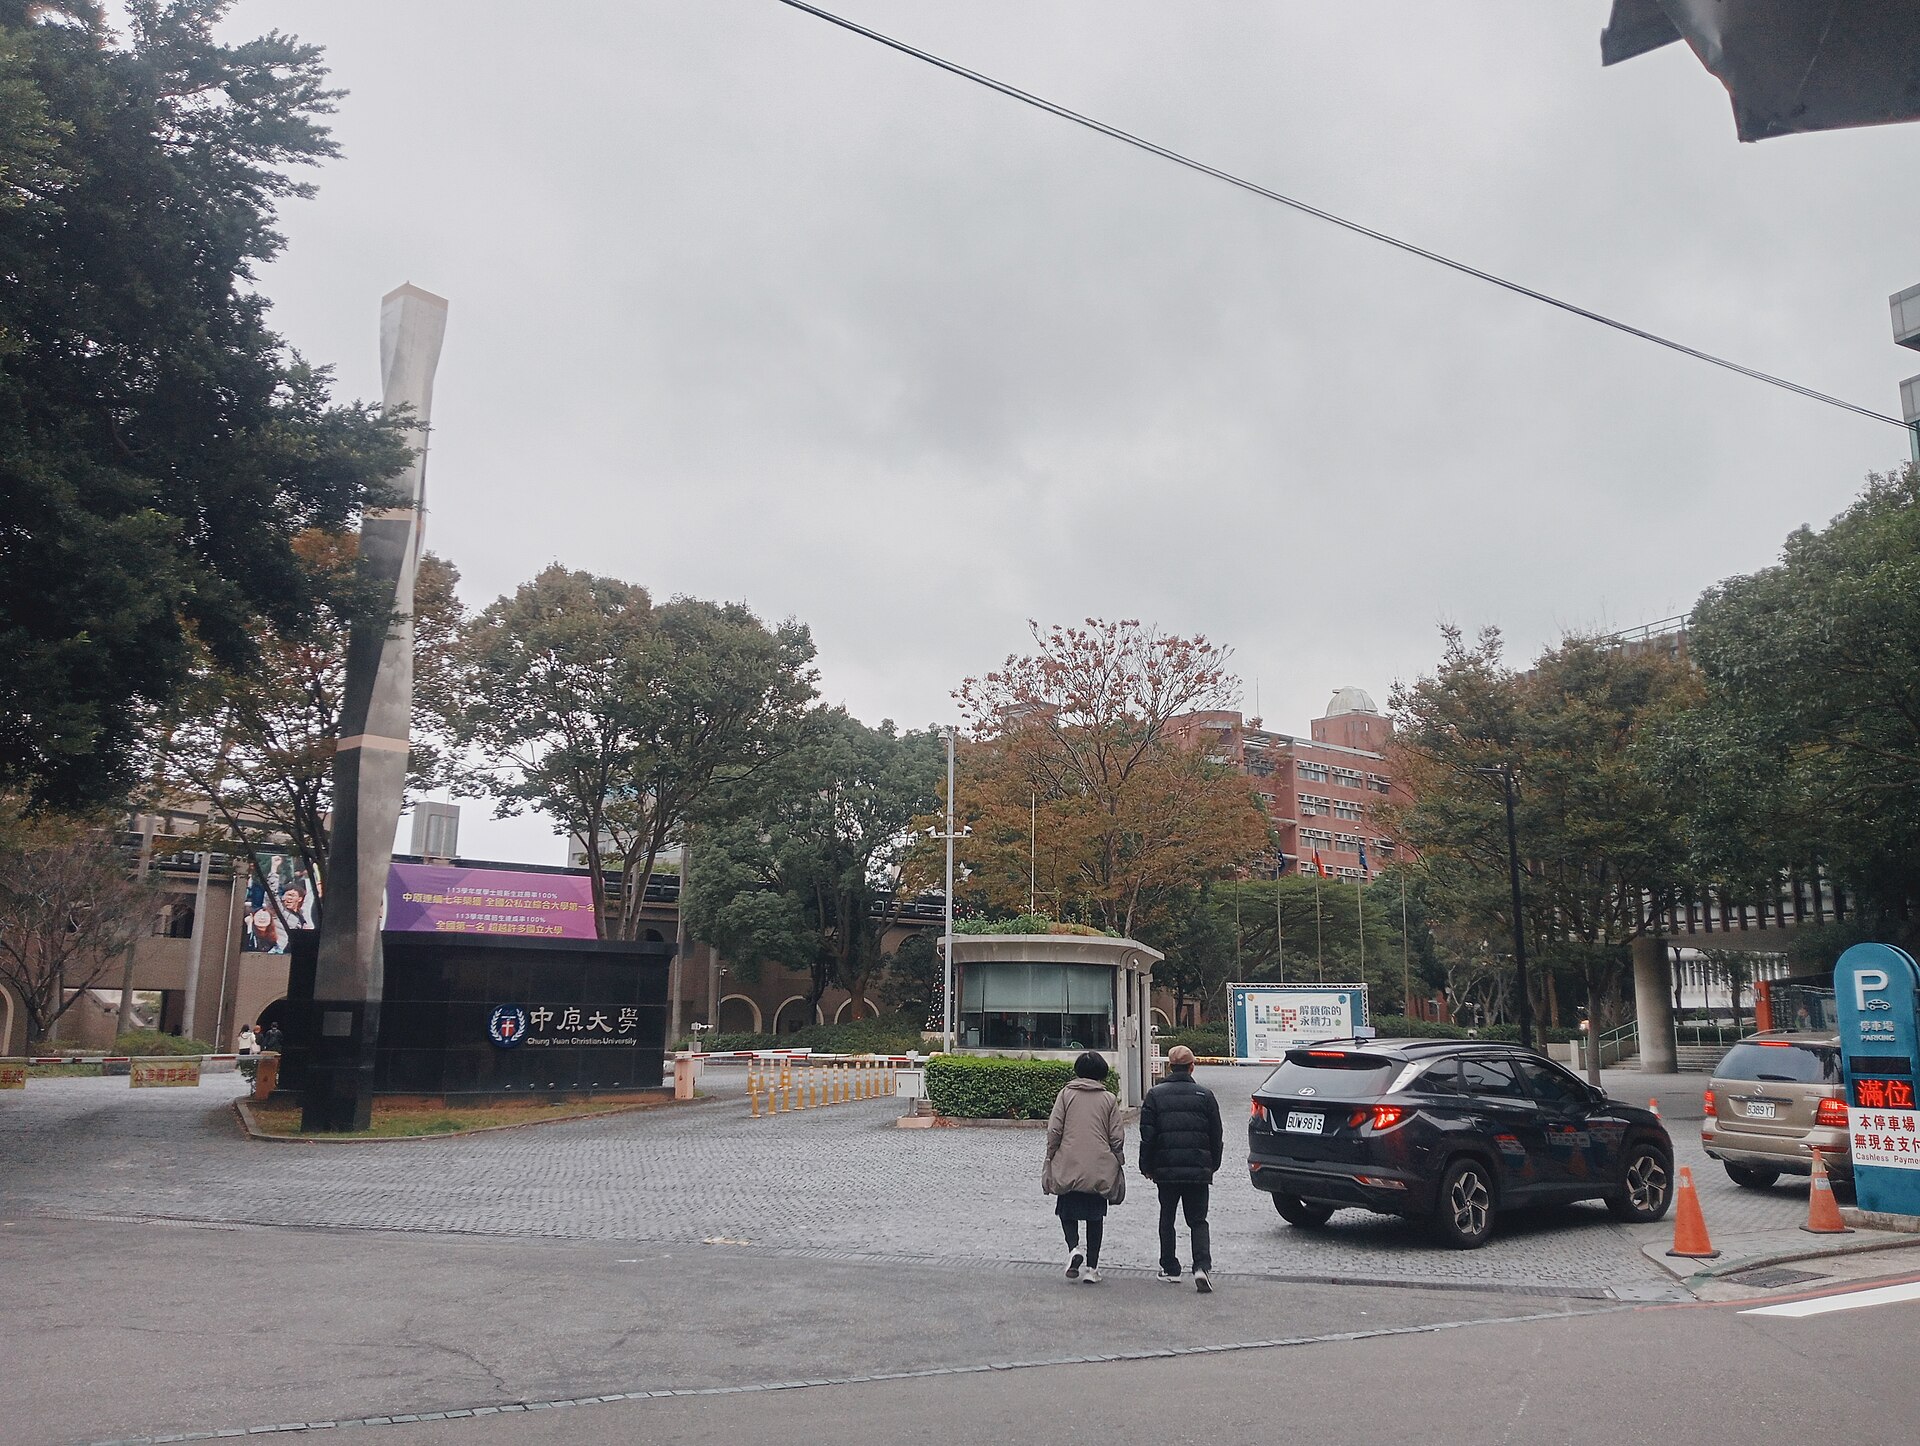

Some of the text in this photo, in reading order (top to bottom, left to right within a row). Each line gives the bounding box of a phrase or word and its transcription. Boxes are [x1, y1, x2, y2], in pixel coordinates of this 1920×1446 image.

[436, 920, 486, 932] 全國第一名
[1853, 969, 1889, 1011] P
[1299, 1005, 1342, 1016] 解鎖你的
[530, 1006, 639, 1034] 中原大學
[1299, 1016, 1331, 1026] 永續力
[1860, 1020, 1895, 1032] 停車場
[527, 1037, 550, 1046] Chung
[571, 1037, 602, 1045] Christian
[603, 1037, 637, 1047] University
[1860, 1034, 1895, 1042] PARKING
[1858, 1080, 1913, 1107] 滿位
[1859, 1114, 1916, 1133] 本停車場
[1856, 1153, 1890, 1162] Cashless
